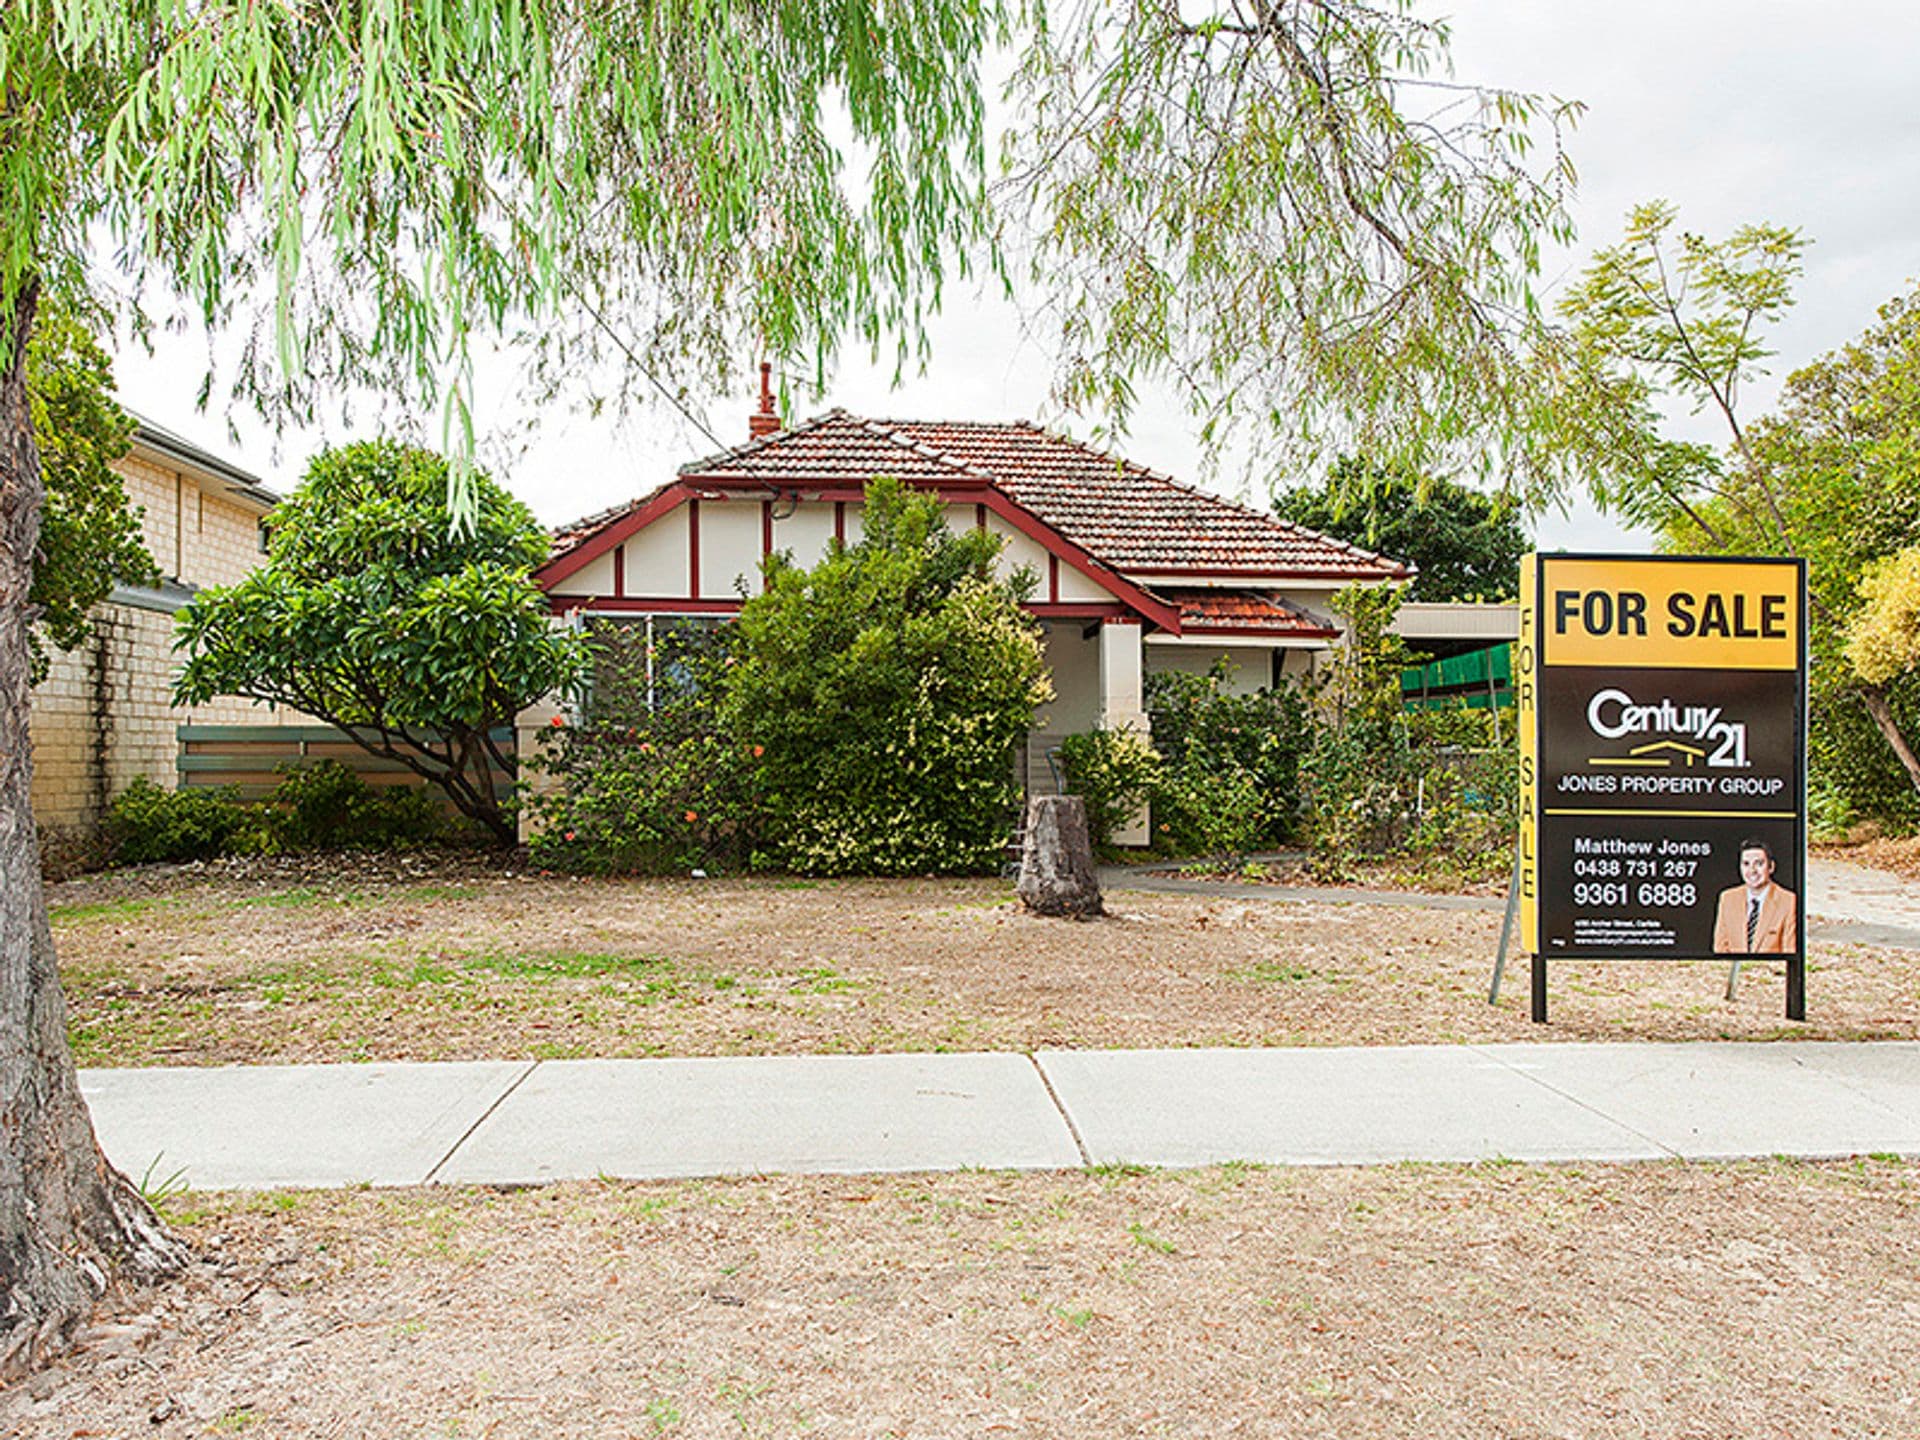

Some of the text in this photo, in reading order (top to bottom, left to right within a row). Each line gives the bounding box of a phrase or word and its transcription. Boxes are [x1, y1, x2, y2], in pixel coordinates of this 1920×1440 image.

[1555, 590, 1787, 638] FOR SALE
[1588, 688, 1721, 740] Century
[1520, 608, 1534, 898] FOR SALE
[1557, 775, 1784, 795] JONES PROPERTY GROUP
[1574, 838, 1711, 855] Matthew Jones
[1574, 860, 1698, 877] 0438 731 267
[1574, 883, 1697, 906] 9361 6888
